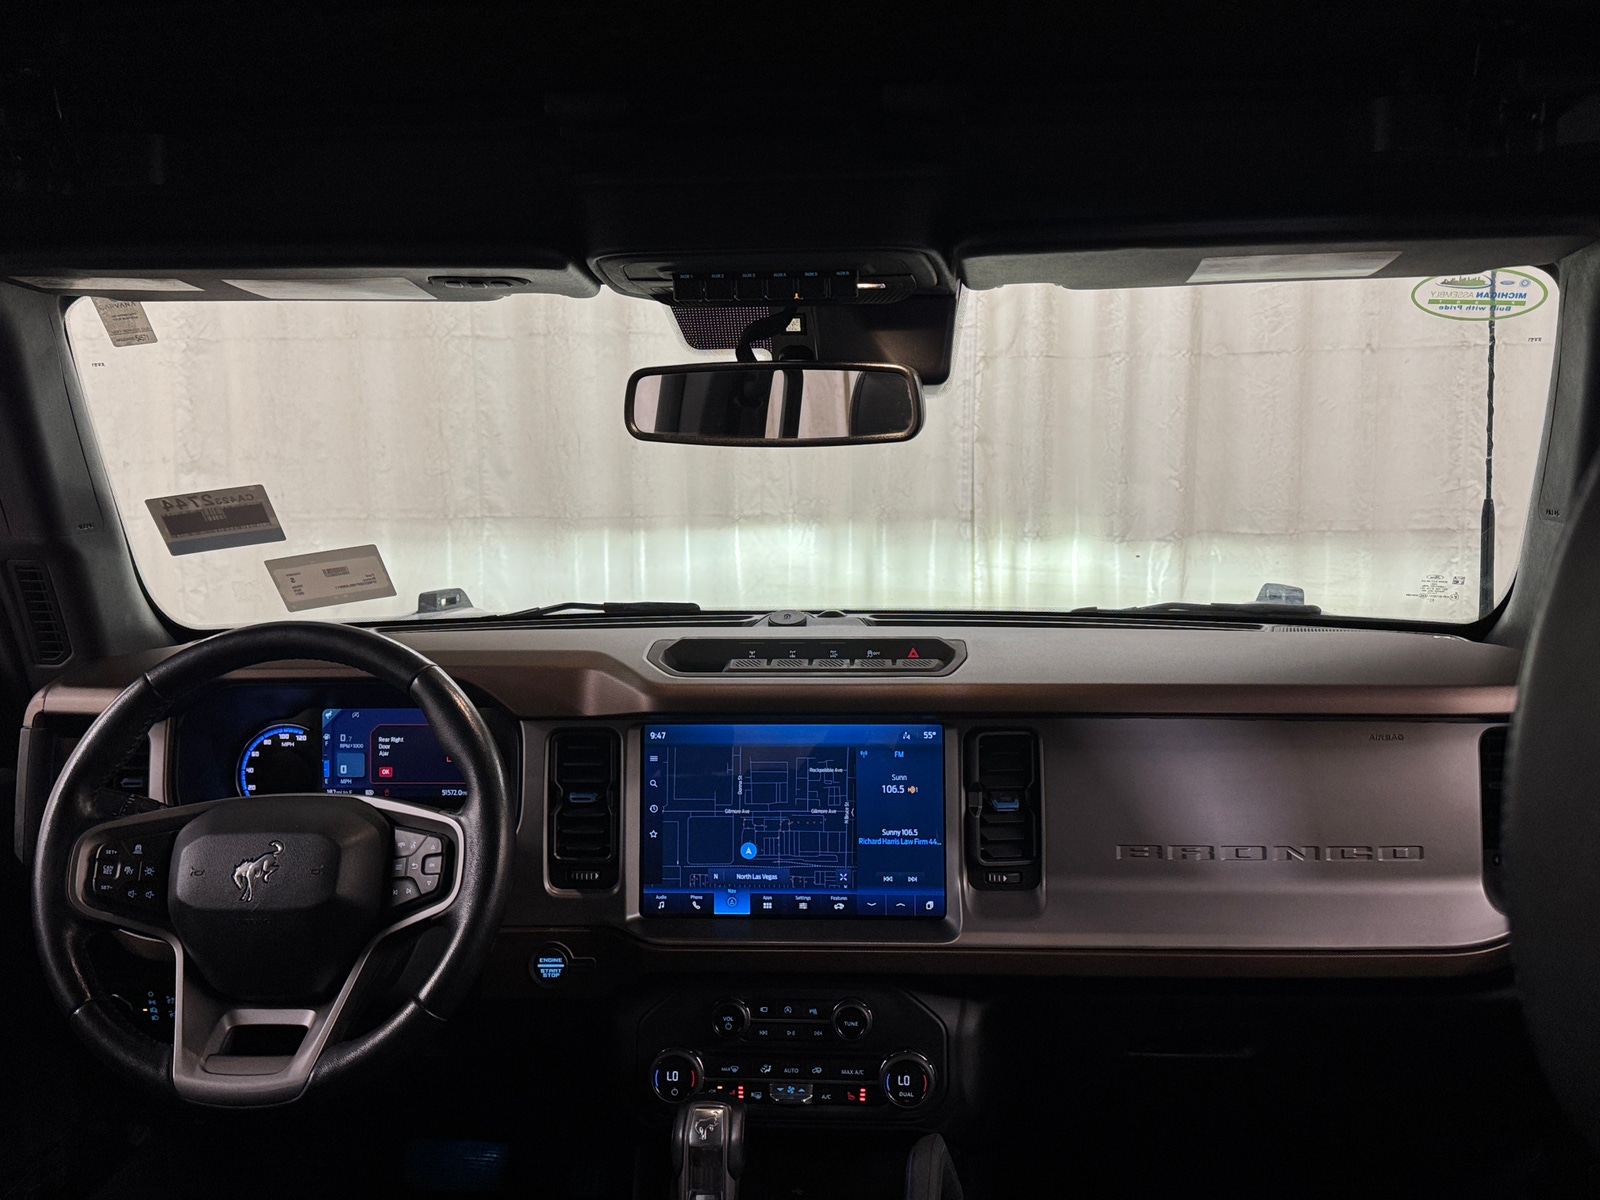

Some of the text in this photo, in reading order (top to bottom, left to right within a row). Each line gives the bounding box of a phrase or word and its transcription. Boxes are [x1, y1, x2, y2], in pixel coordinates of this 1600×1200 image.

[98, 302, 136, 310] CARVANA
[340, 765, 347, 774] 0
[882, 784, 904, 794] 106.5
[1116, 844, 1424, 861] BRONCO
[667, 1071, 678, 1081] LO
[898, 1075, 910, 1086] LO
